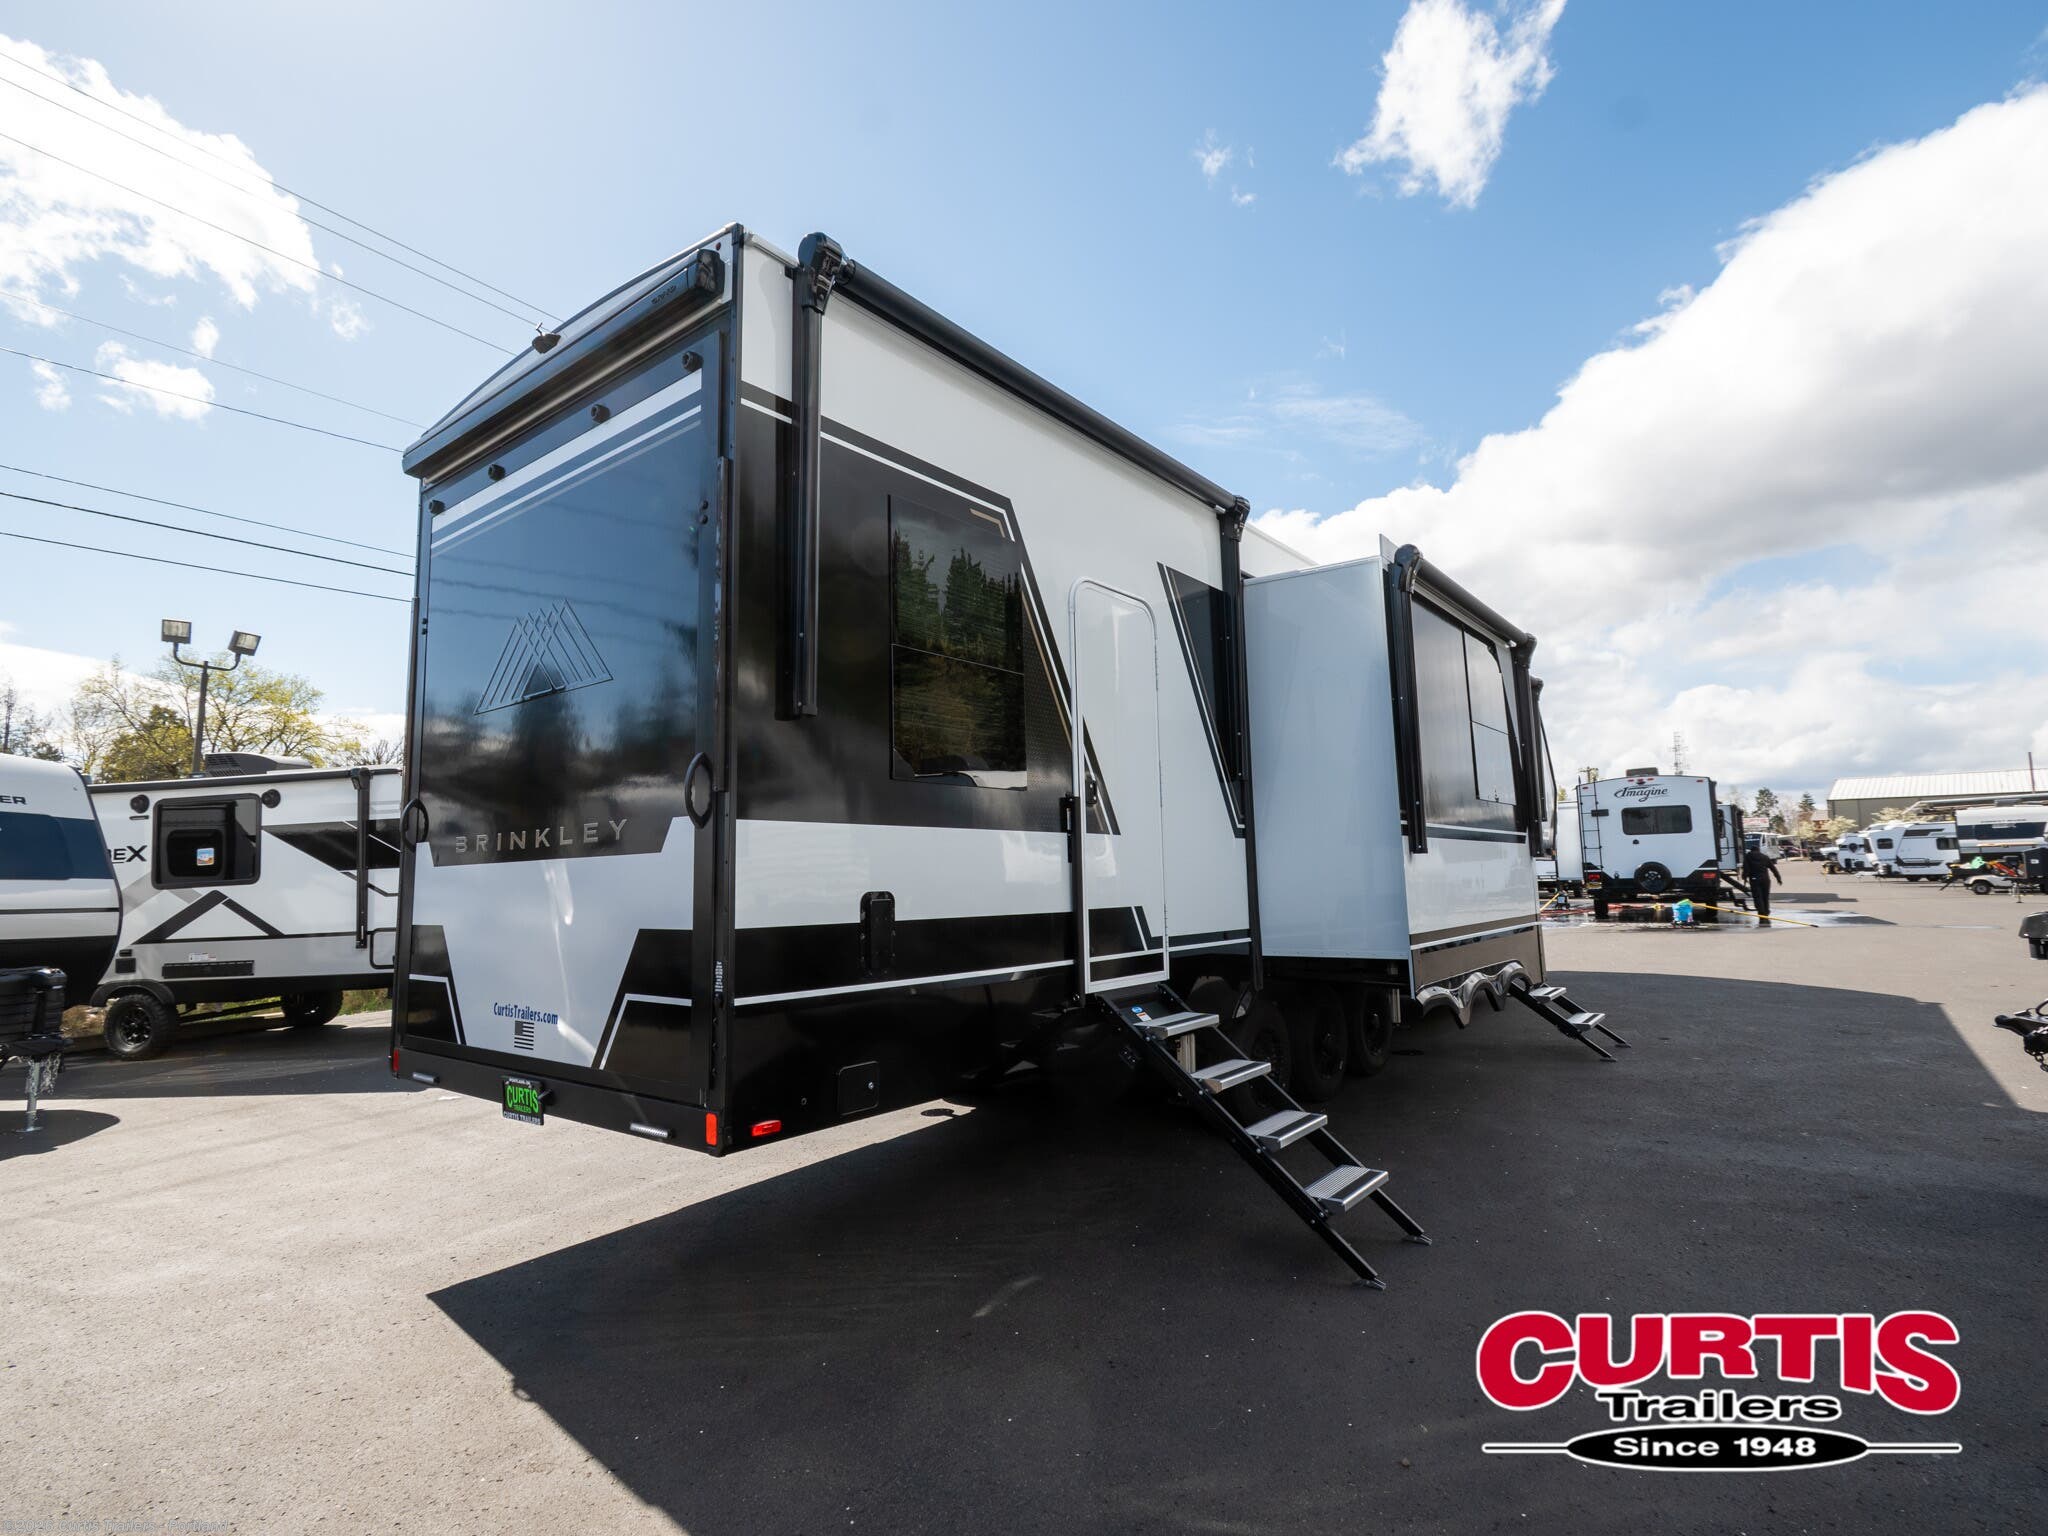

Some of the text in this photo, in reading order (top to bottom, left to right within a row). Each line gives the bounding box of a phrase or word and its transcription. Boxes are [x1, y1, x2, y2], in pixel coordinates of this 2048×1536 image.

[1614, 785, 1669, 802] Imagine
[455, 819, 628, 853] BRINKLEY
[107, 845, 148, 863] EX
[493, 1002, 559, 1025] CurtisTrailers.com
[506, 1085, 539, 1113] CURTIS
